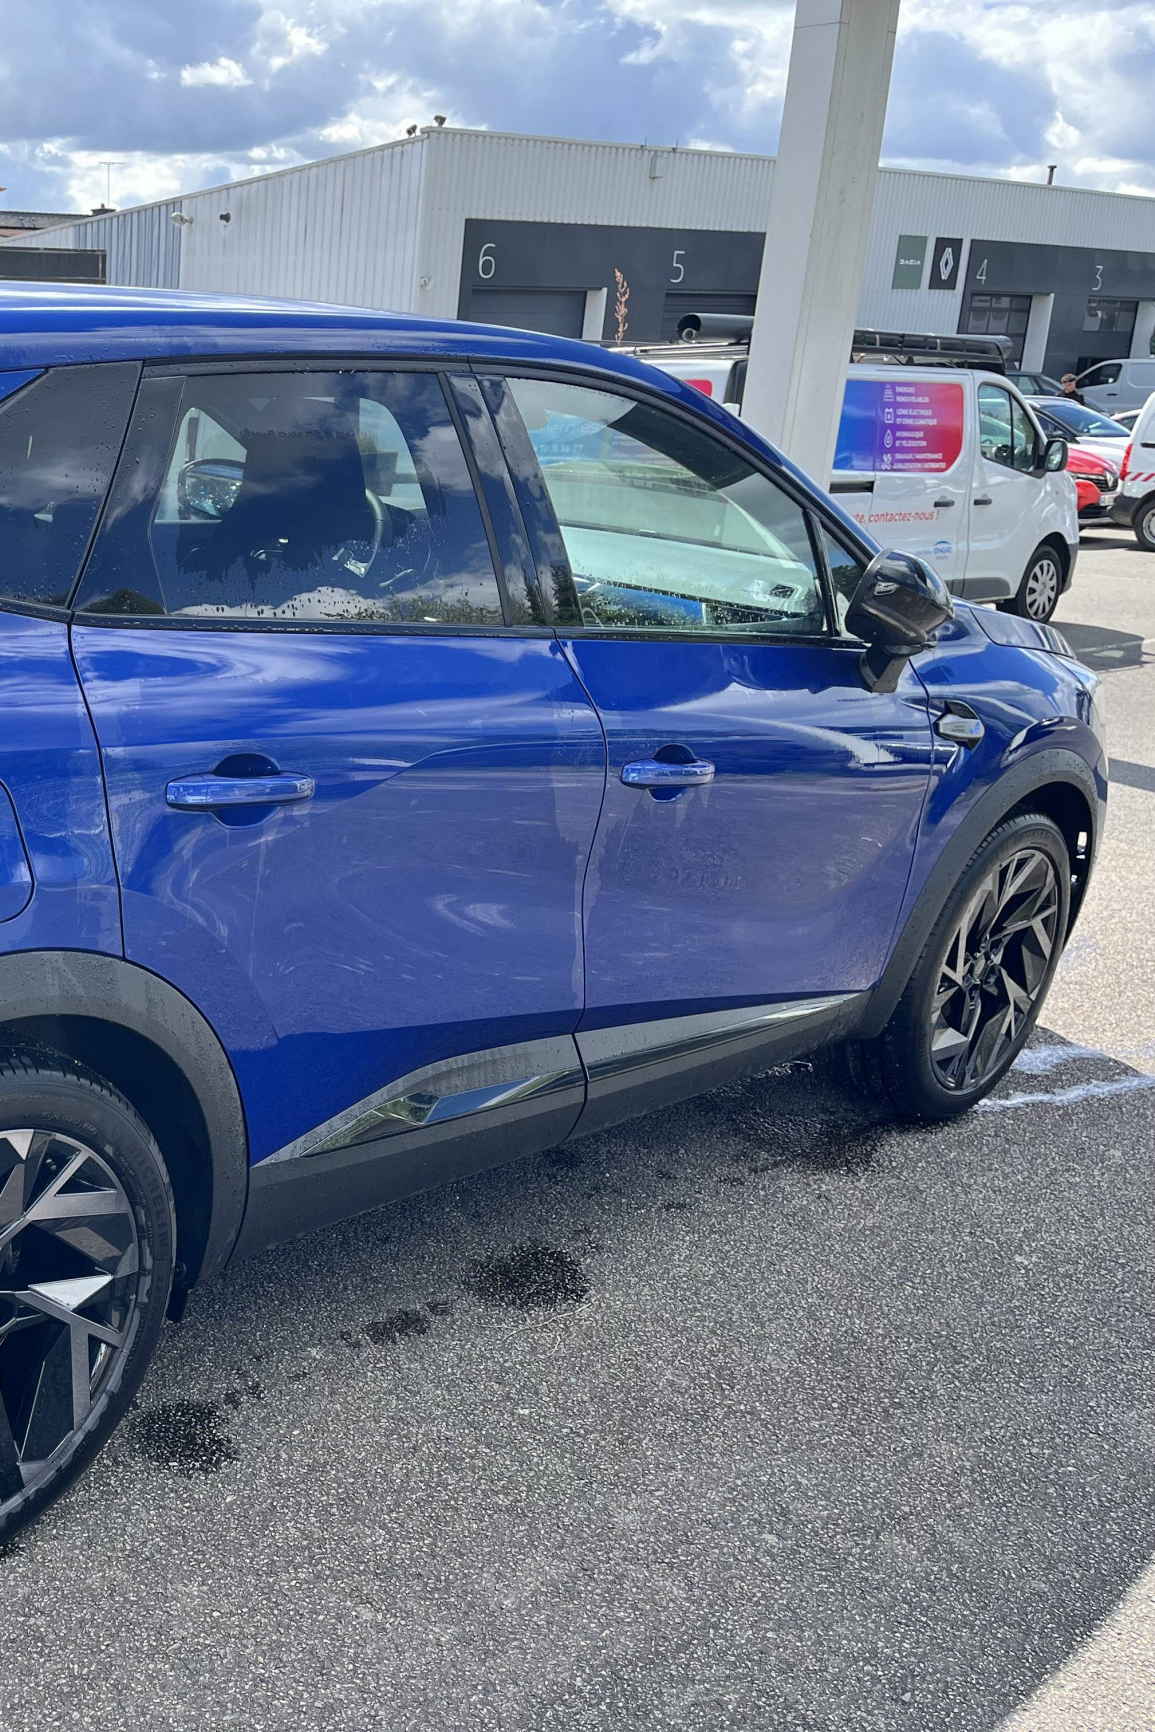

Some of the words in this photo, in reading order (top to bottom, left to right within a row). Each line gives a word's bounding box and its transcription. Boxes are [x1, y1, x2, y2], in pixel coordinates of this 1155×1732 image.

[478, 243, 496, 279] 6
[670, 250, 686, 283] 5
[976, 258, 988, 285] 4
[1092, 265, 1103, 291] 3
